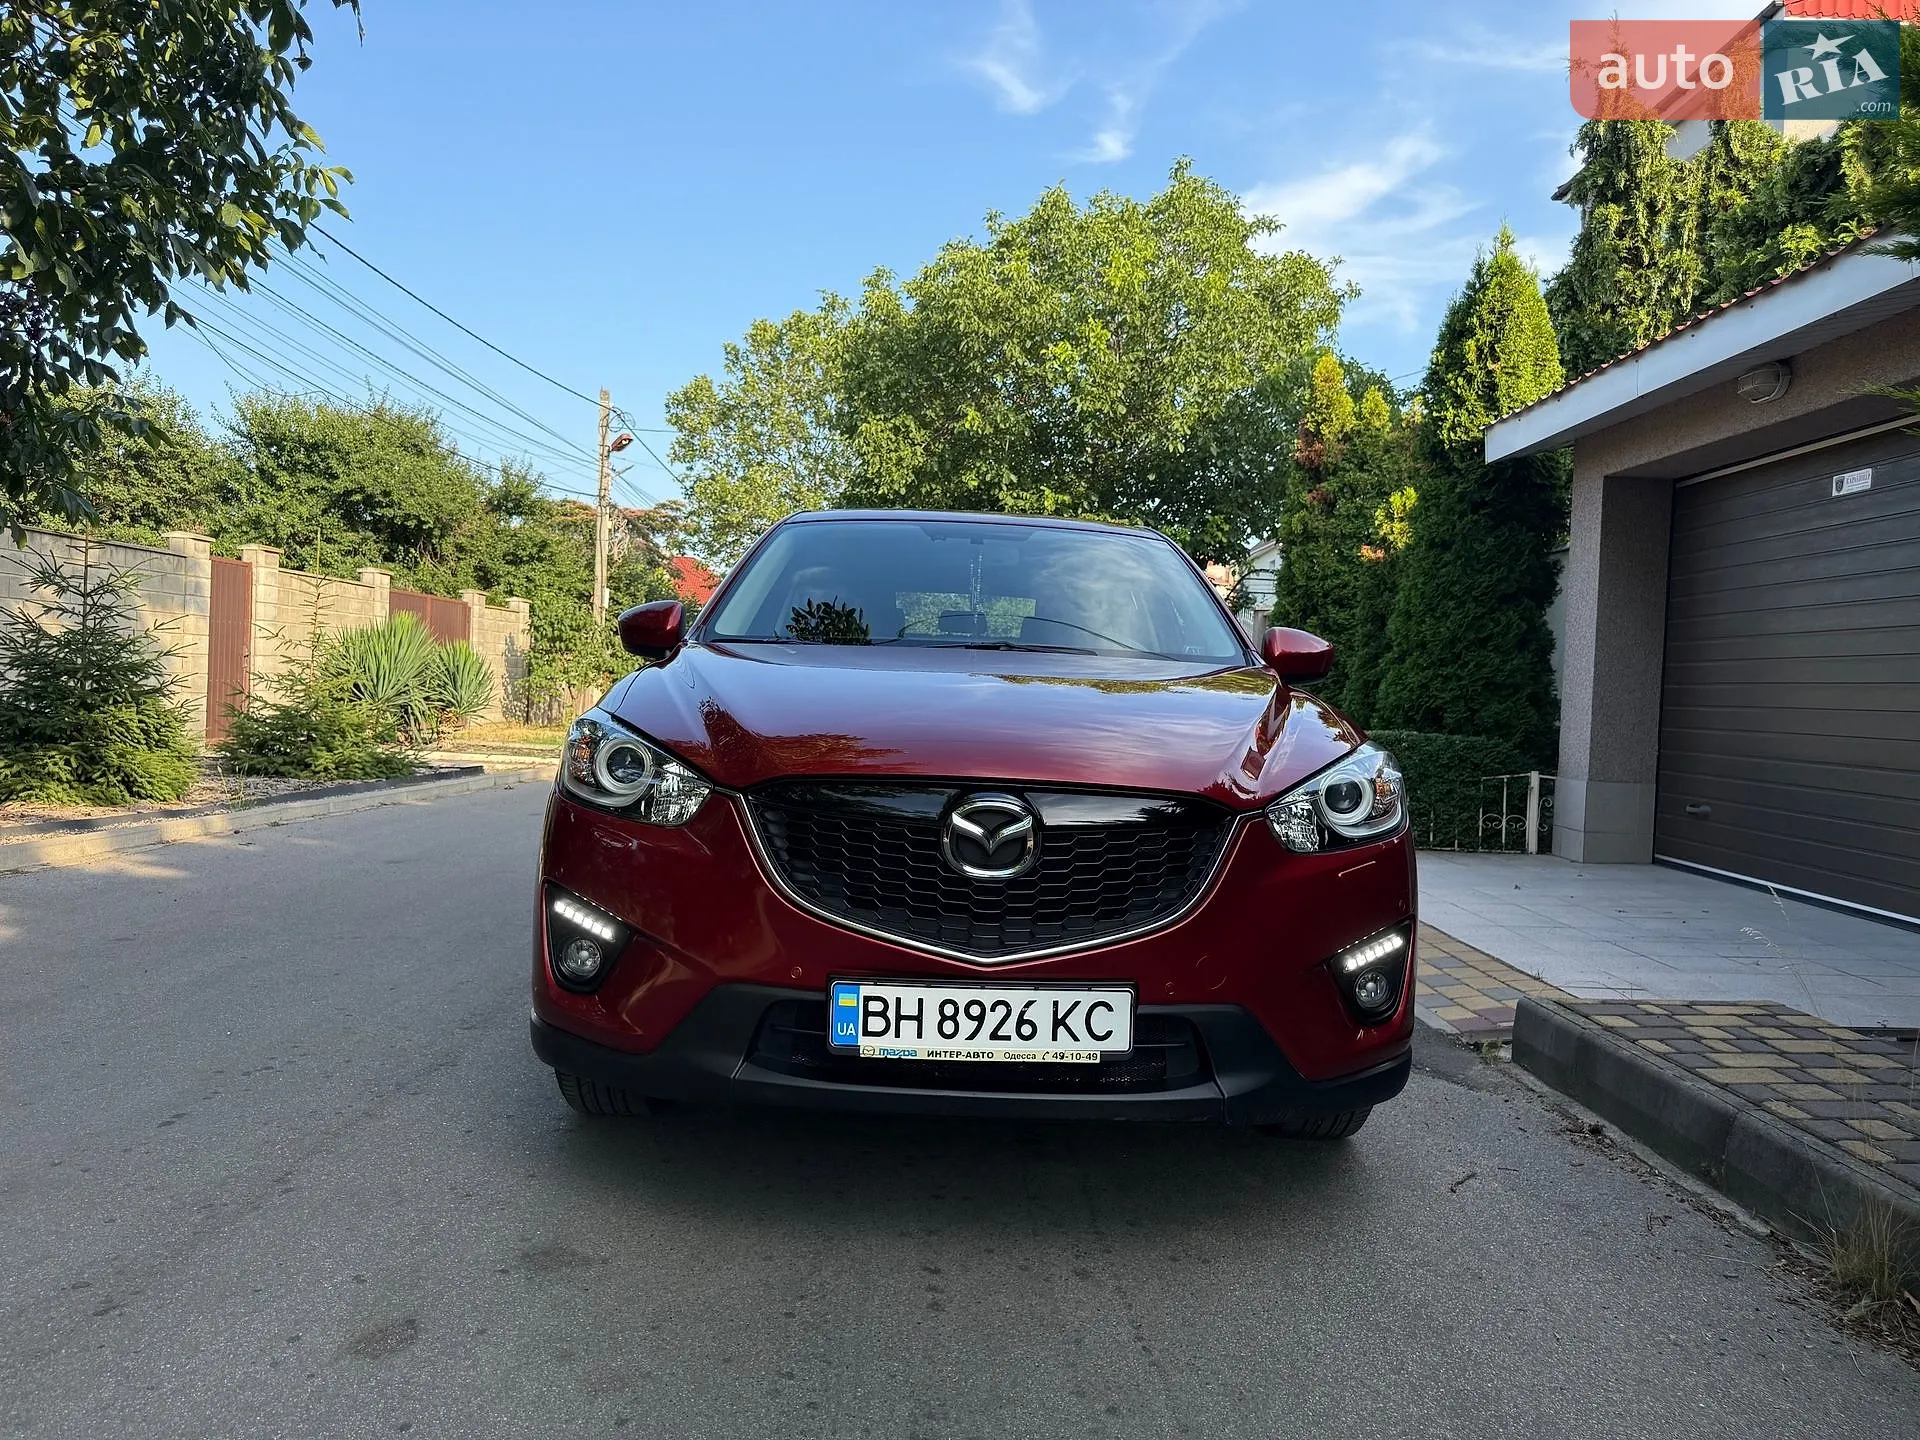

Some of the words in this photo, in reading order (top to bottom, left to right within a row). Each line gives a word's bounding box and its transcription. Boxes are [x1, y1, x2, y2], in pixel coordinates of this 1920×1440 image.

[861, 995, 923, 1038] BH
[936, 998, 1038, 1041] 8926
[1050, 1000, 1114, 1042] KC
[837, 1022, 857, 1036] UA
[927, 1050, 994, 1060] ИНТЕР-АВТО
[1003, 1051, 1037, 1061] Одесса
[1051, 1051, 1098, 1061] 49-10-49
